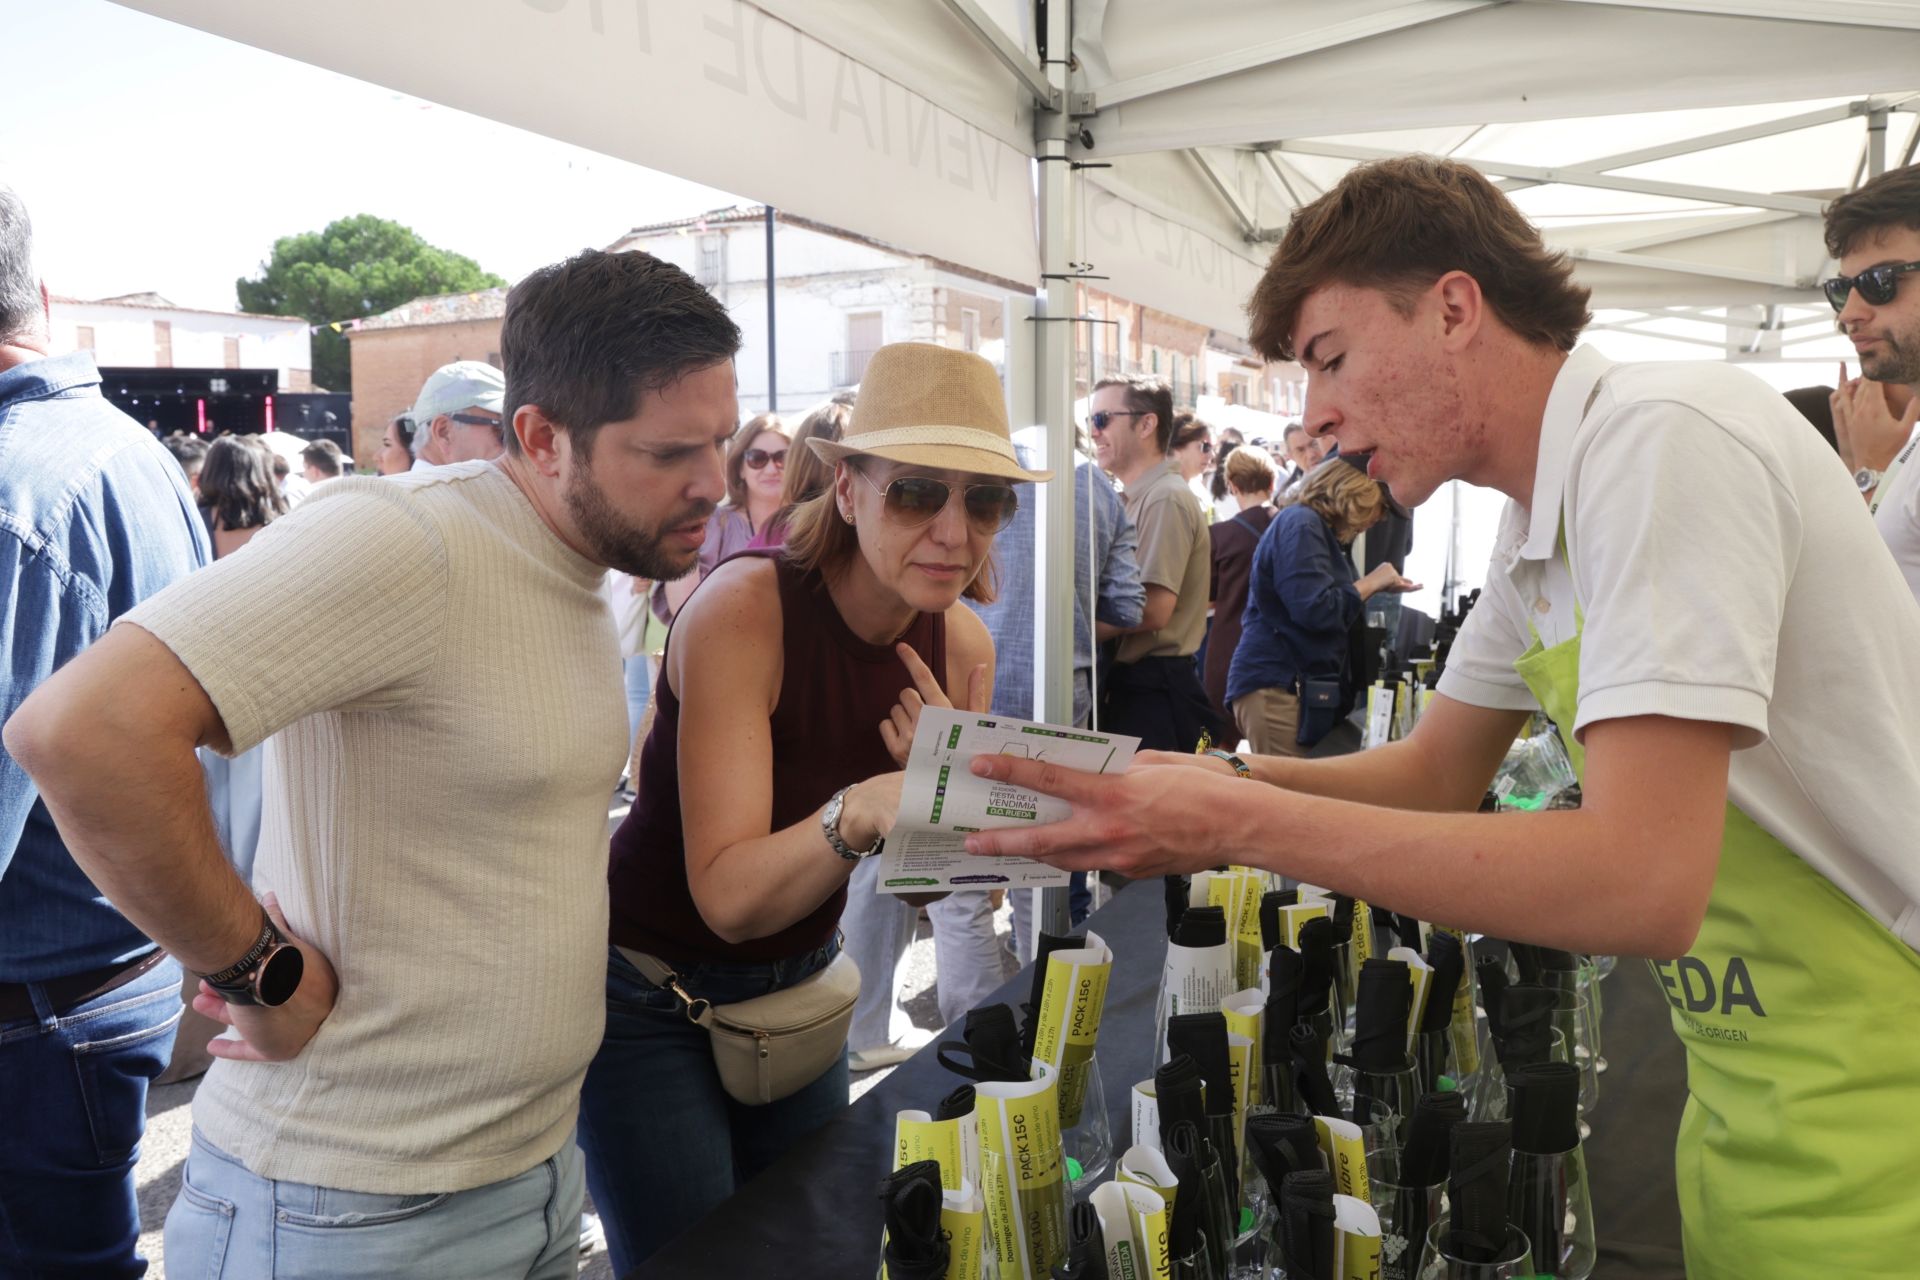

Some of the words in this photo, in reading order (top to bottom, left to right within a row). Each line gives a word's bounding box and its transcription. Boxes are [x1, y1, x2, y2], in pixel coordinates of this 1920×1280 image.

[989, 798, 1036, 810] VENDIMIA
[990, 791, 1015, 800] FIESTA
[1005, 809, 1032, 818] RUEDA
[1239, 909, 1249, 935] PACK
[1078, 979, 1091, 1003] 15€
[1072, 1005, 1087, 1036] PACK
[1705, 1027, 1749, 1041] ORIGEN
[1031, 1105, 1040, 1122] vino
[1013, 1114, 1028, 1140] 15€
[1017, 1144, 1033, 1181] PACK
[995, 1174, 1003, 1189] 17h
[998, 1197, 1007, 1212] 12h
[1000, 1212, 1008, 1224] de
[964, 1227, 972, 1247] vino
[1003, 1225, 1015, 1263] Domingo:
[961, 1249, 969, 1260] de
[1033, 1237, 1046, 1275] PACK
[1120, 1245, 1134, 1280] RUEDA
